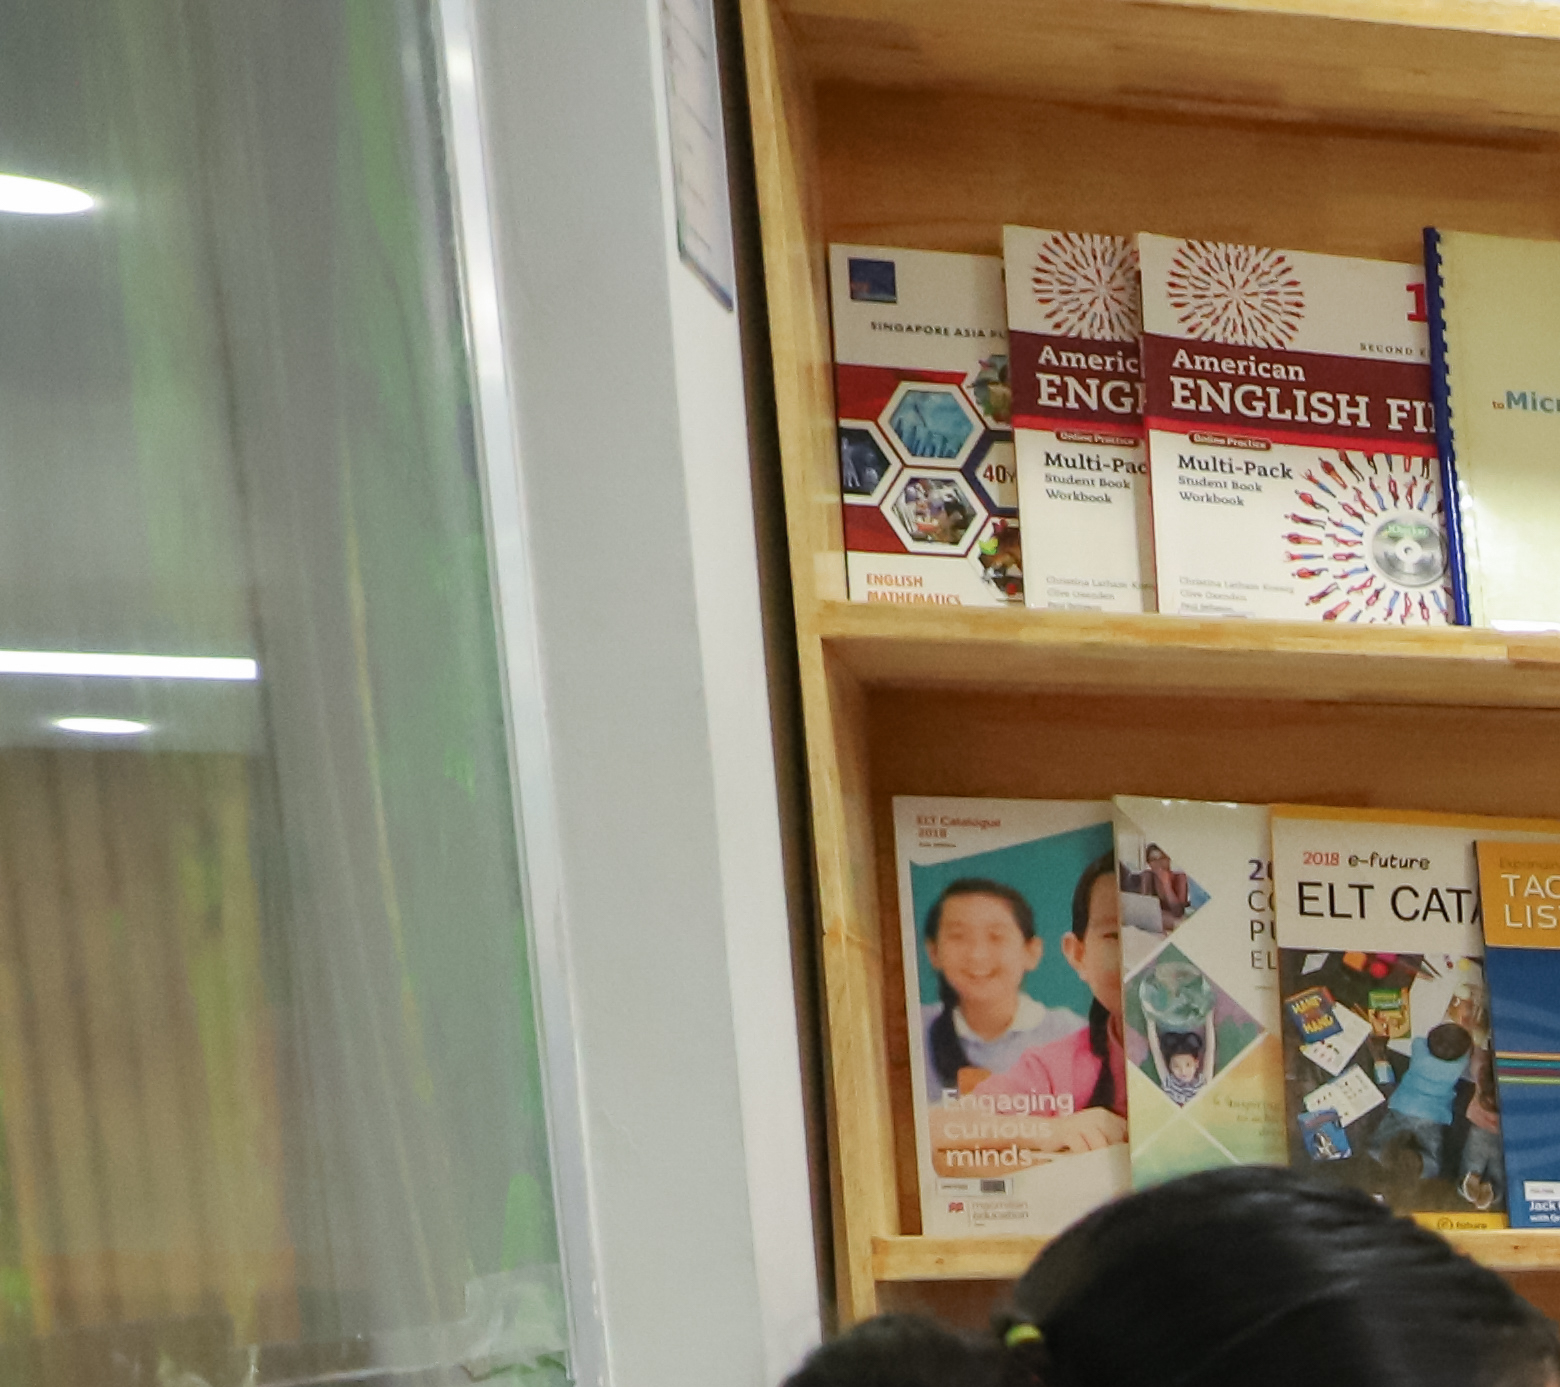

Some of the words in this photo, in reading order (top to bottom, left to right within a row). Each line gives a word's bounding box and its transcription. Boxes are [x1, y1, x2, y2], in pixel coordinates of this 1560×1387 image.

[1406, 282, 1428, 322] 1
[871, 321, 949, 337] SINGAPORE
[1360, 342, 1414, 357] SECOND
[1172, 348, 1306, 382] American
[1169, 376, 1371, 427] ENGLISH
[1178, 453, 1294, 480] Multi-Pack
[1044, 474, 1096, 489] Student
[1099, 479, 1131, 490] Book
[1178, 475, 1228, 490] Student
[1232, 481, 1263, 493] Book
[1046, 488, 1112, 504] Workbook
[1180, 491, 1245, 507] Workbook
[866, 573, 924, 588] ENGLISH
[867, 592, 962, 606] MATHEMATICS
[1303, 851, 1340, 867] 2018
[1347, 852, 1431, 871] e-future
[1297, 881, 1375, 920] ELT
[941, 1088, 1076, 1116] Engaging
[943, 1121, 1053, 1140] curious
[945, 1143, 1033, 1167] minds
[1529, 1201, 1557, 1213] Jack
